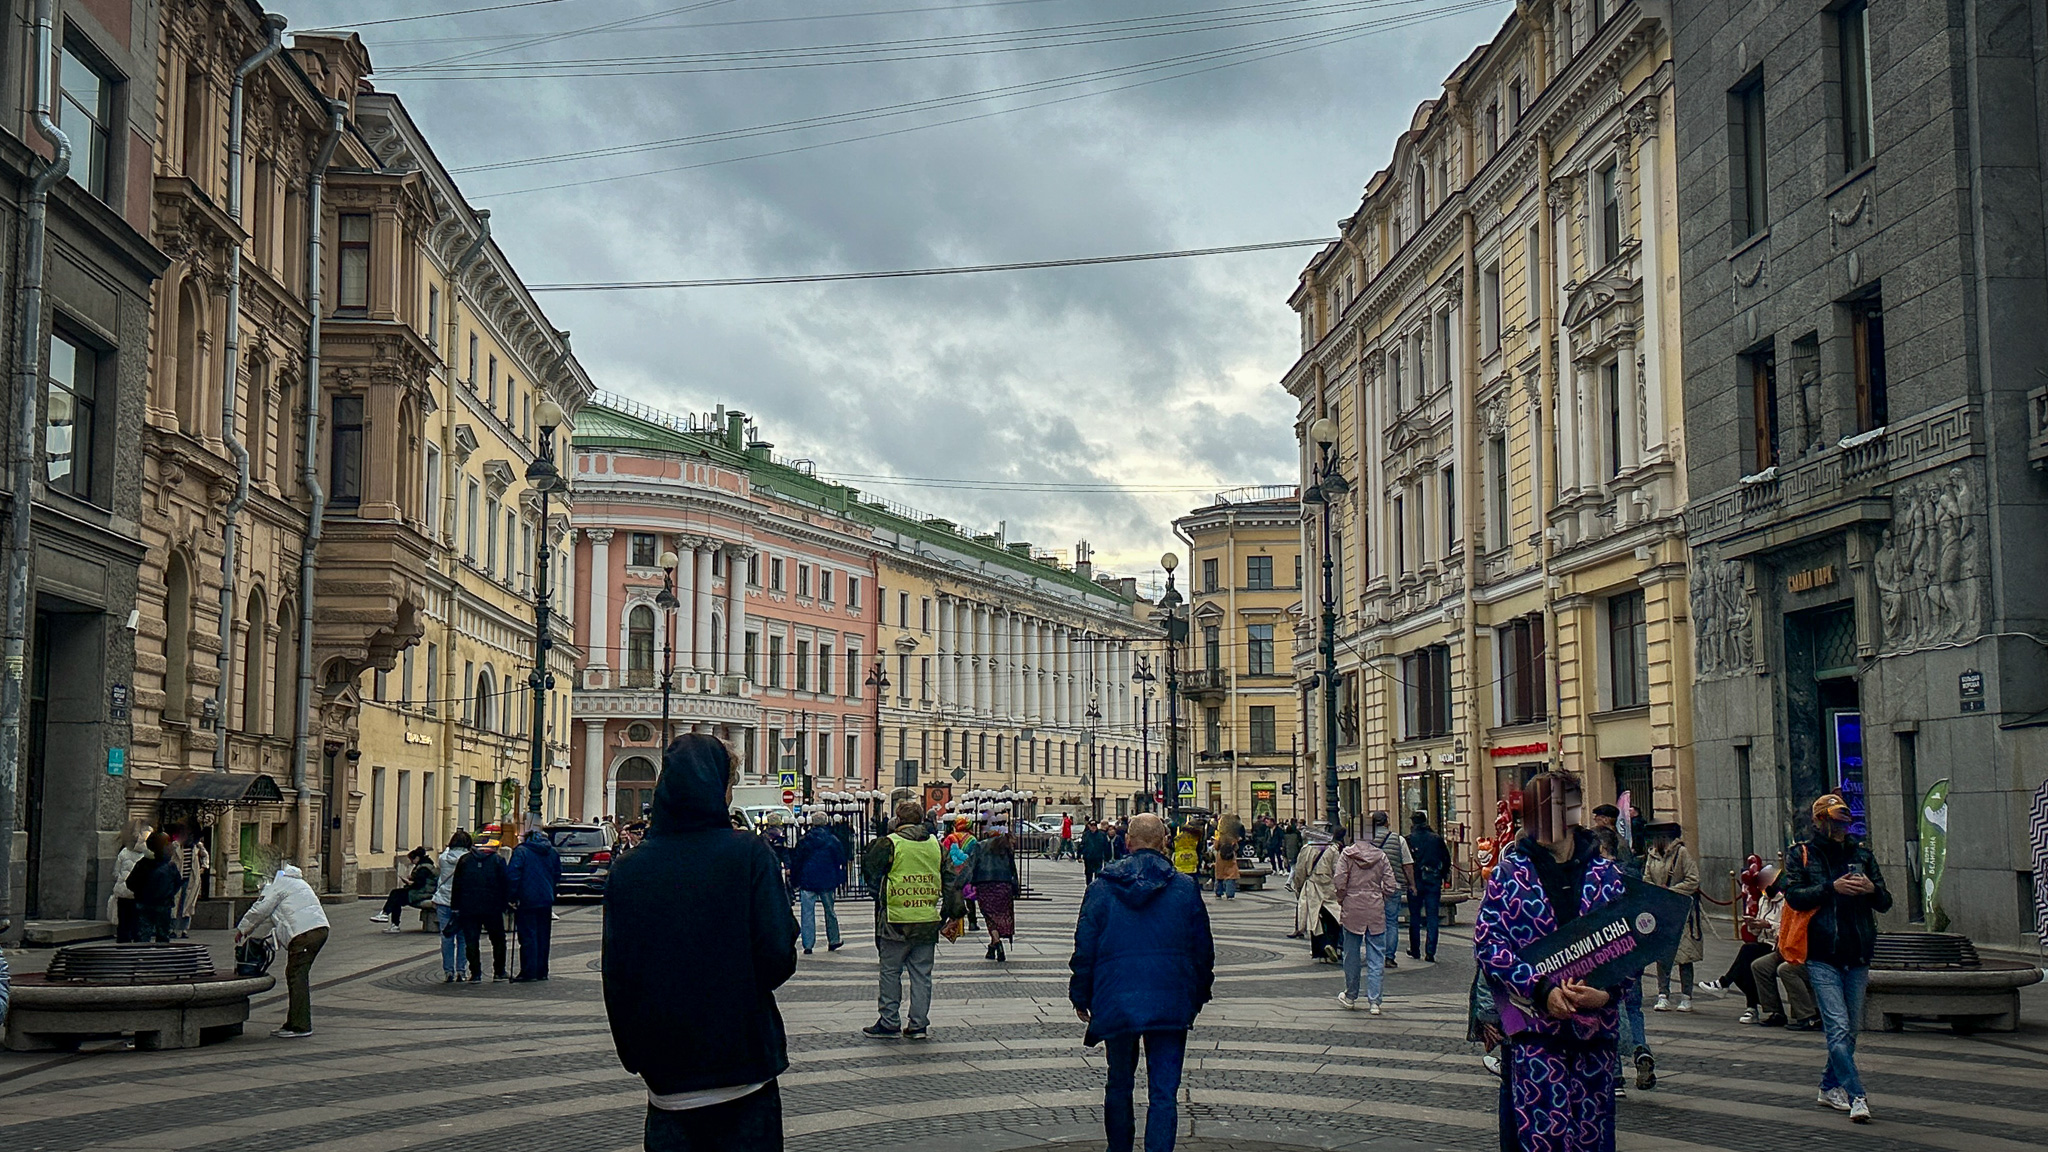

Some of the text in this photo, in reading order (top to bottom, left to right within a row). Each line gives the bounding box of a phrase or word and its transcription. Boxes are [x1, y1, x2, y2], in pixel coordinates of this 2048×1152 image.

[1788, 565, 1832, 592] СМАЙЛ ПАРК
[902, 874, 934, 884] МУЗЕЙ
[1638, 918, 1653, 930] 18+
[1535, 917, 1631, 974] ФАНТАЗИИ И СНЫ
[1594, 935, 1638, 966] ФРЕЙДА
